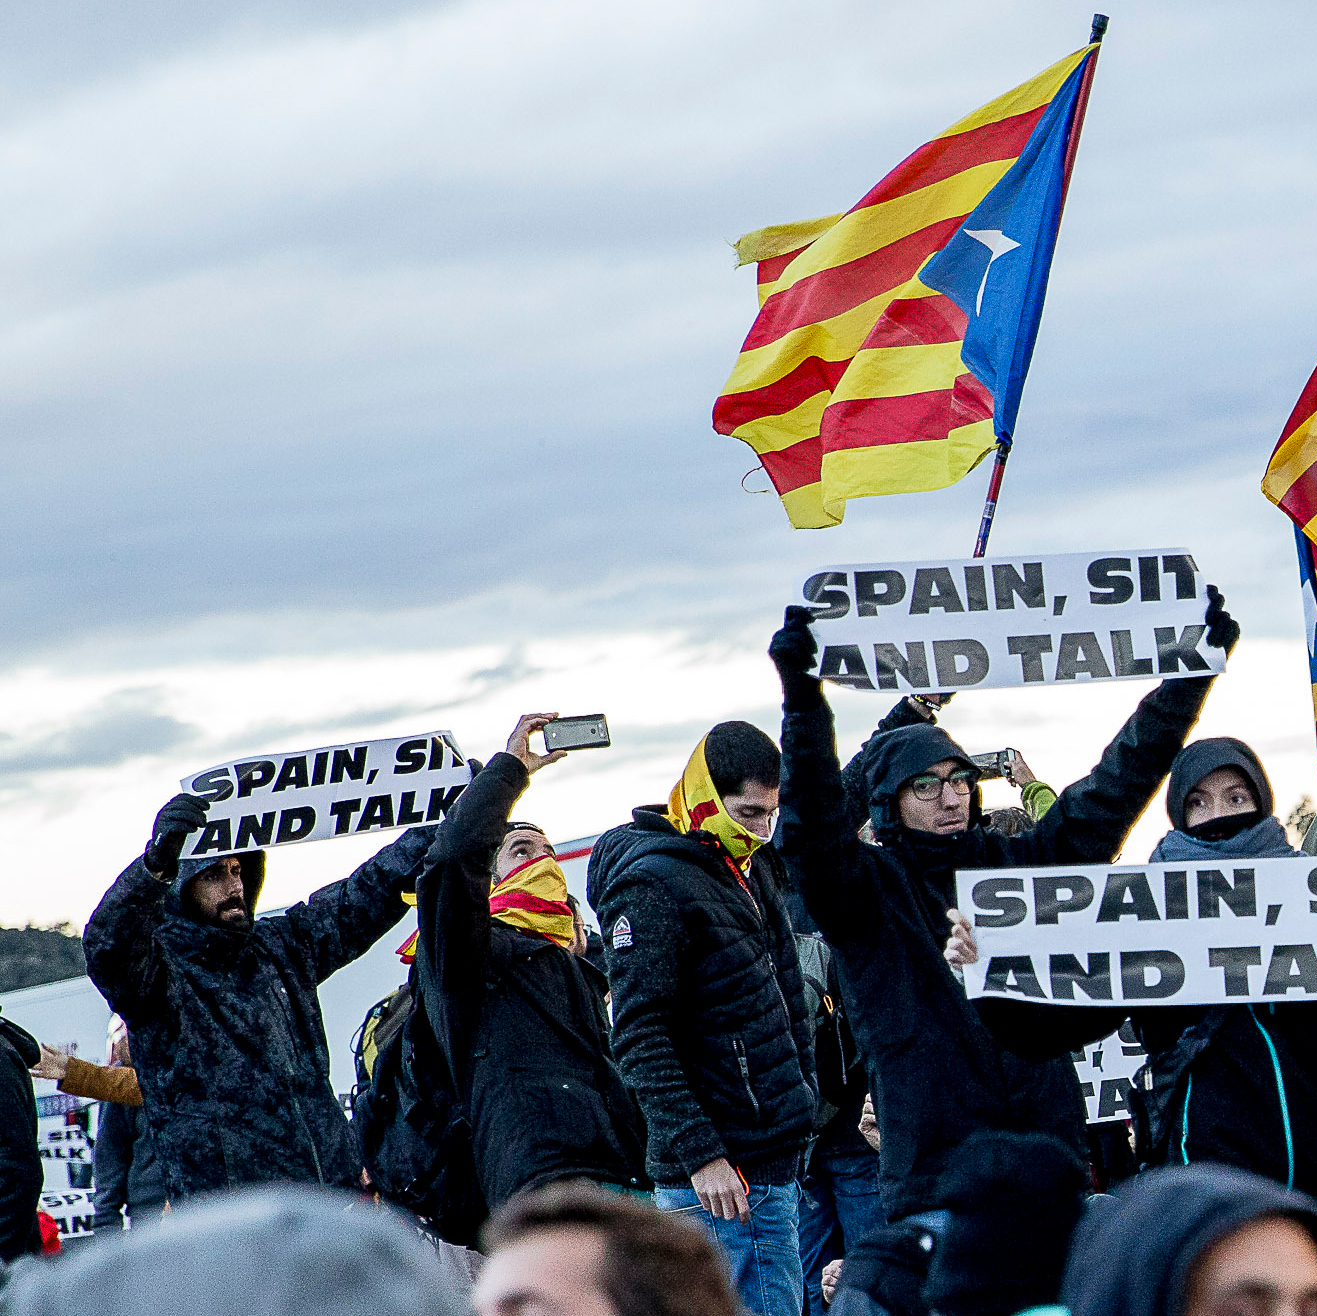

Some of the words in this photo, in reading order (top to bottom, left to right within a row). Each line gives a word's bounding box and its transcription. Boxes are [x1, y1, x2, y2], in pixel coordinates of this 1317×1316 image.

[803, 562, 1068, 620] SPAIN,
[1087, 554, 1200, 606] SIT
[819, 638, 990, 690] AND
[1007, 624, 1212, 682] TALK
[192, 746, 379, 802] SPAIN,
[191, 806, 317, 855] AND
[330, 784, 468, 836] TALK
[972, 868, 1283, 928] SPAIN,
[982, 949, 1186, 1001] AND
